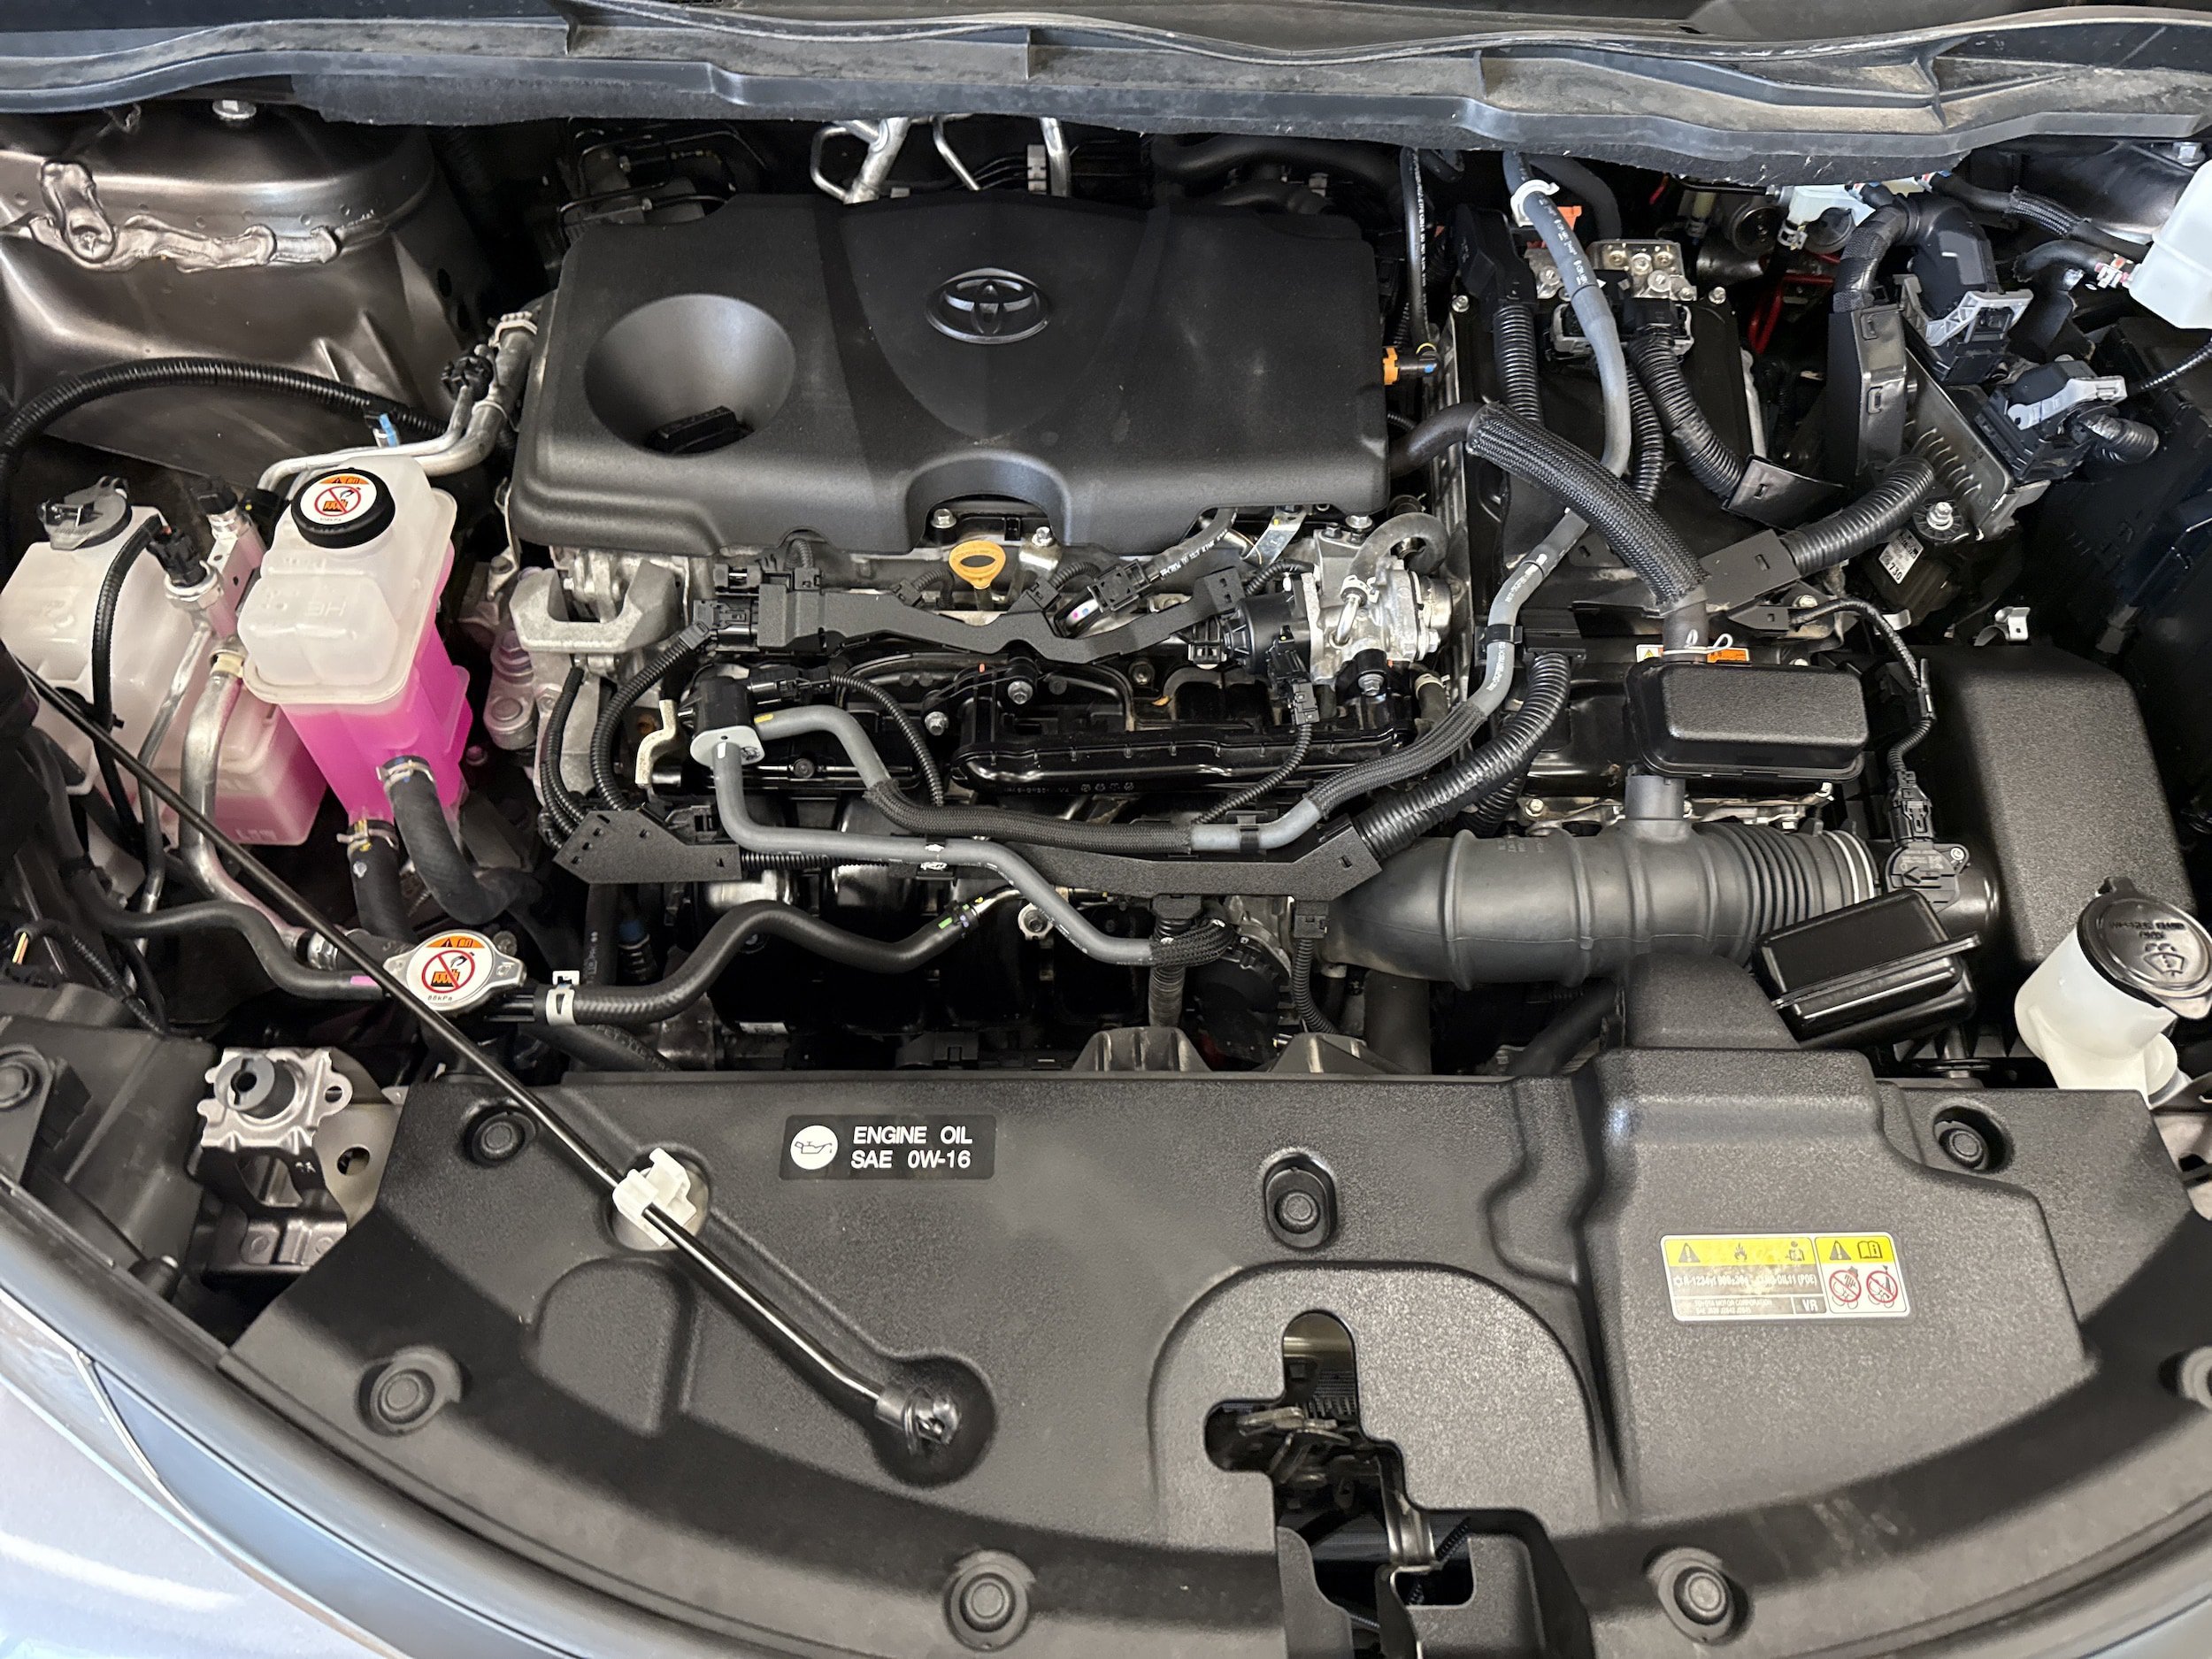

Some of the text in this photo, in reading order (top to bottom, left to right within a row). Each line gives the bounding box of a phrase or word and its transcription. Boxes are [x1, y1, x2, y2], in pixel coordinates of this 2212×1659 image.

[852, 1125, 973, 1145] ENGINE OIL
[850, 1149, 972, 1169] SAE 0W-16
[1802, 1300, 1818, 1312] VR
